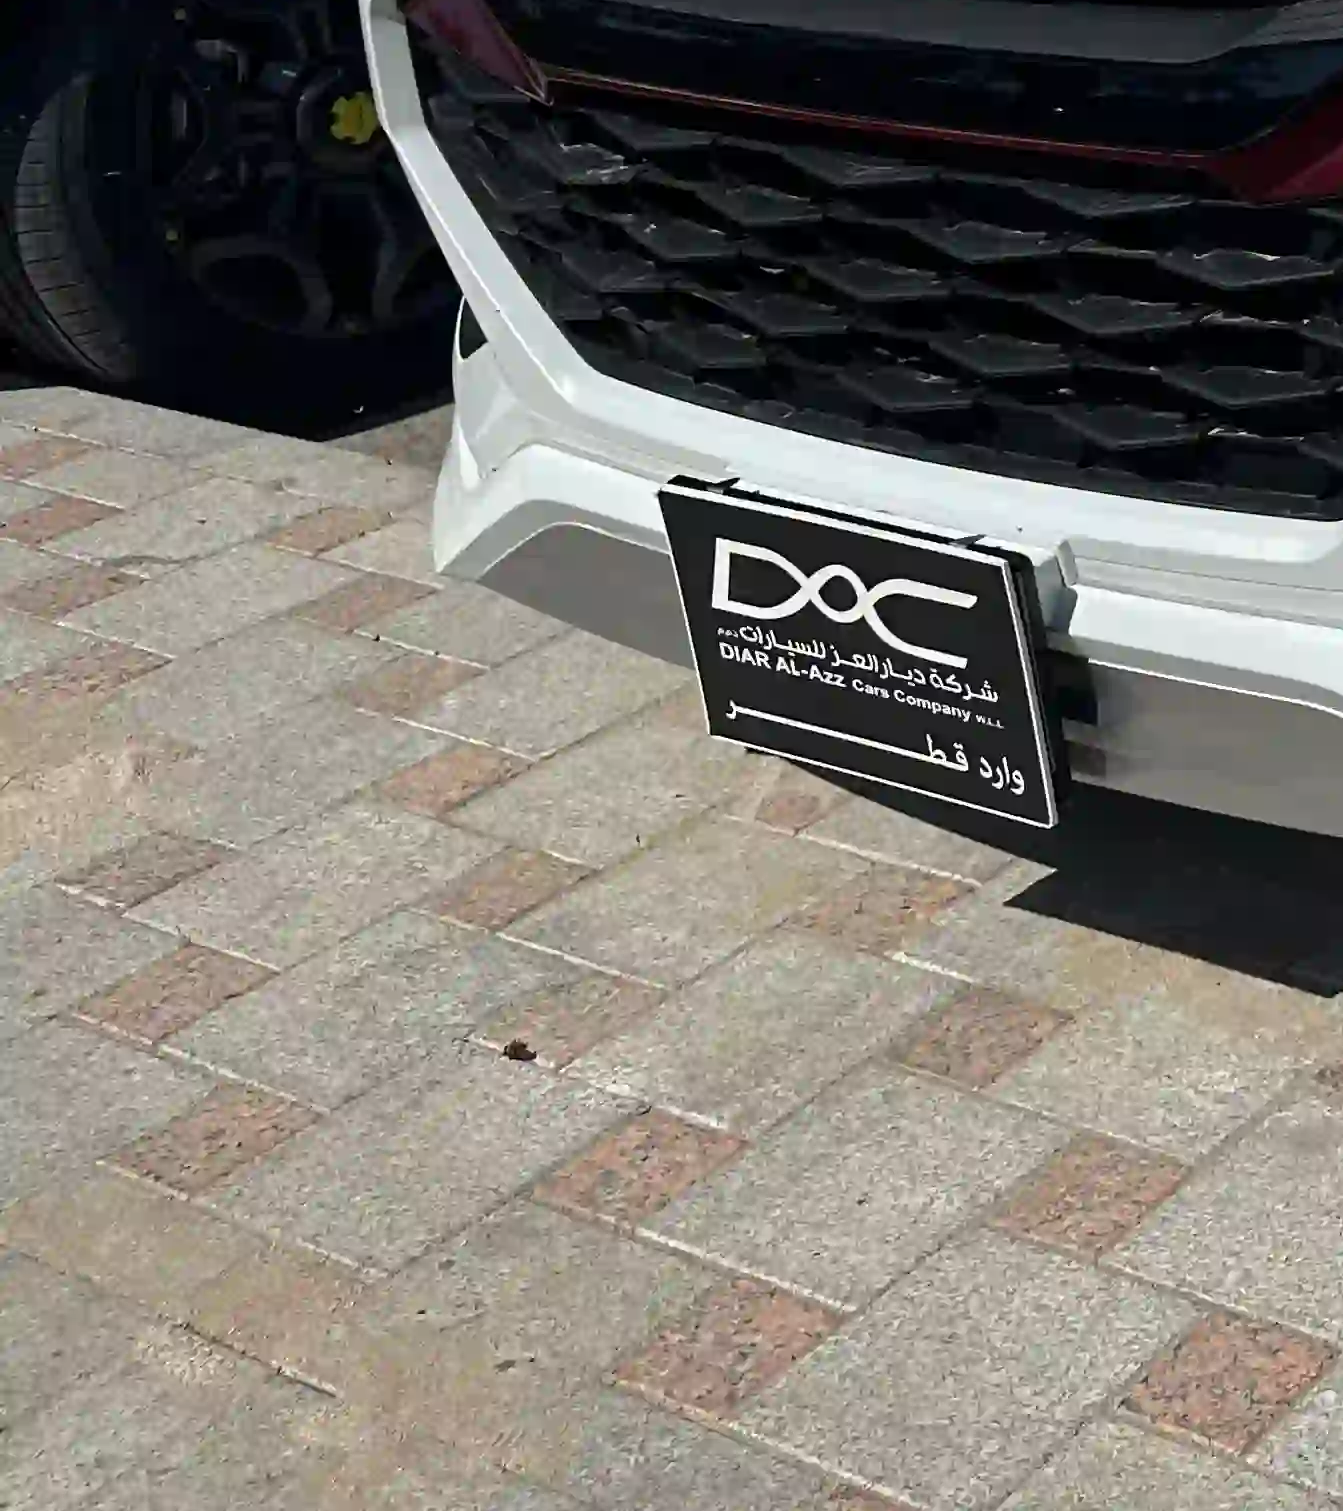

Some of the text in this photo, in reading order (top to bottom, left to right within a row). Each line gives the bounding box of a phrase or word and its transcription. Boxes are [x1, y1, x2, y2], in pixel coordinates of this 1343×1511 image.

[739, 625, 827, 660] للسيارات
[718, 641, 773, 670] DIAR
[851, 678, 891, 699] Cars
[893, 688, 972, 723] Company
[879, 657, 927, 687] ديار
[929, 667, 999, 703] شركة
[725, 700, 1025, 795] وارد قطر
